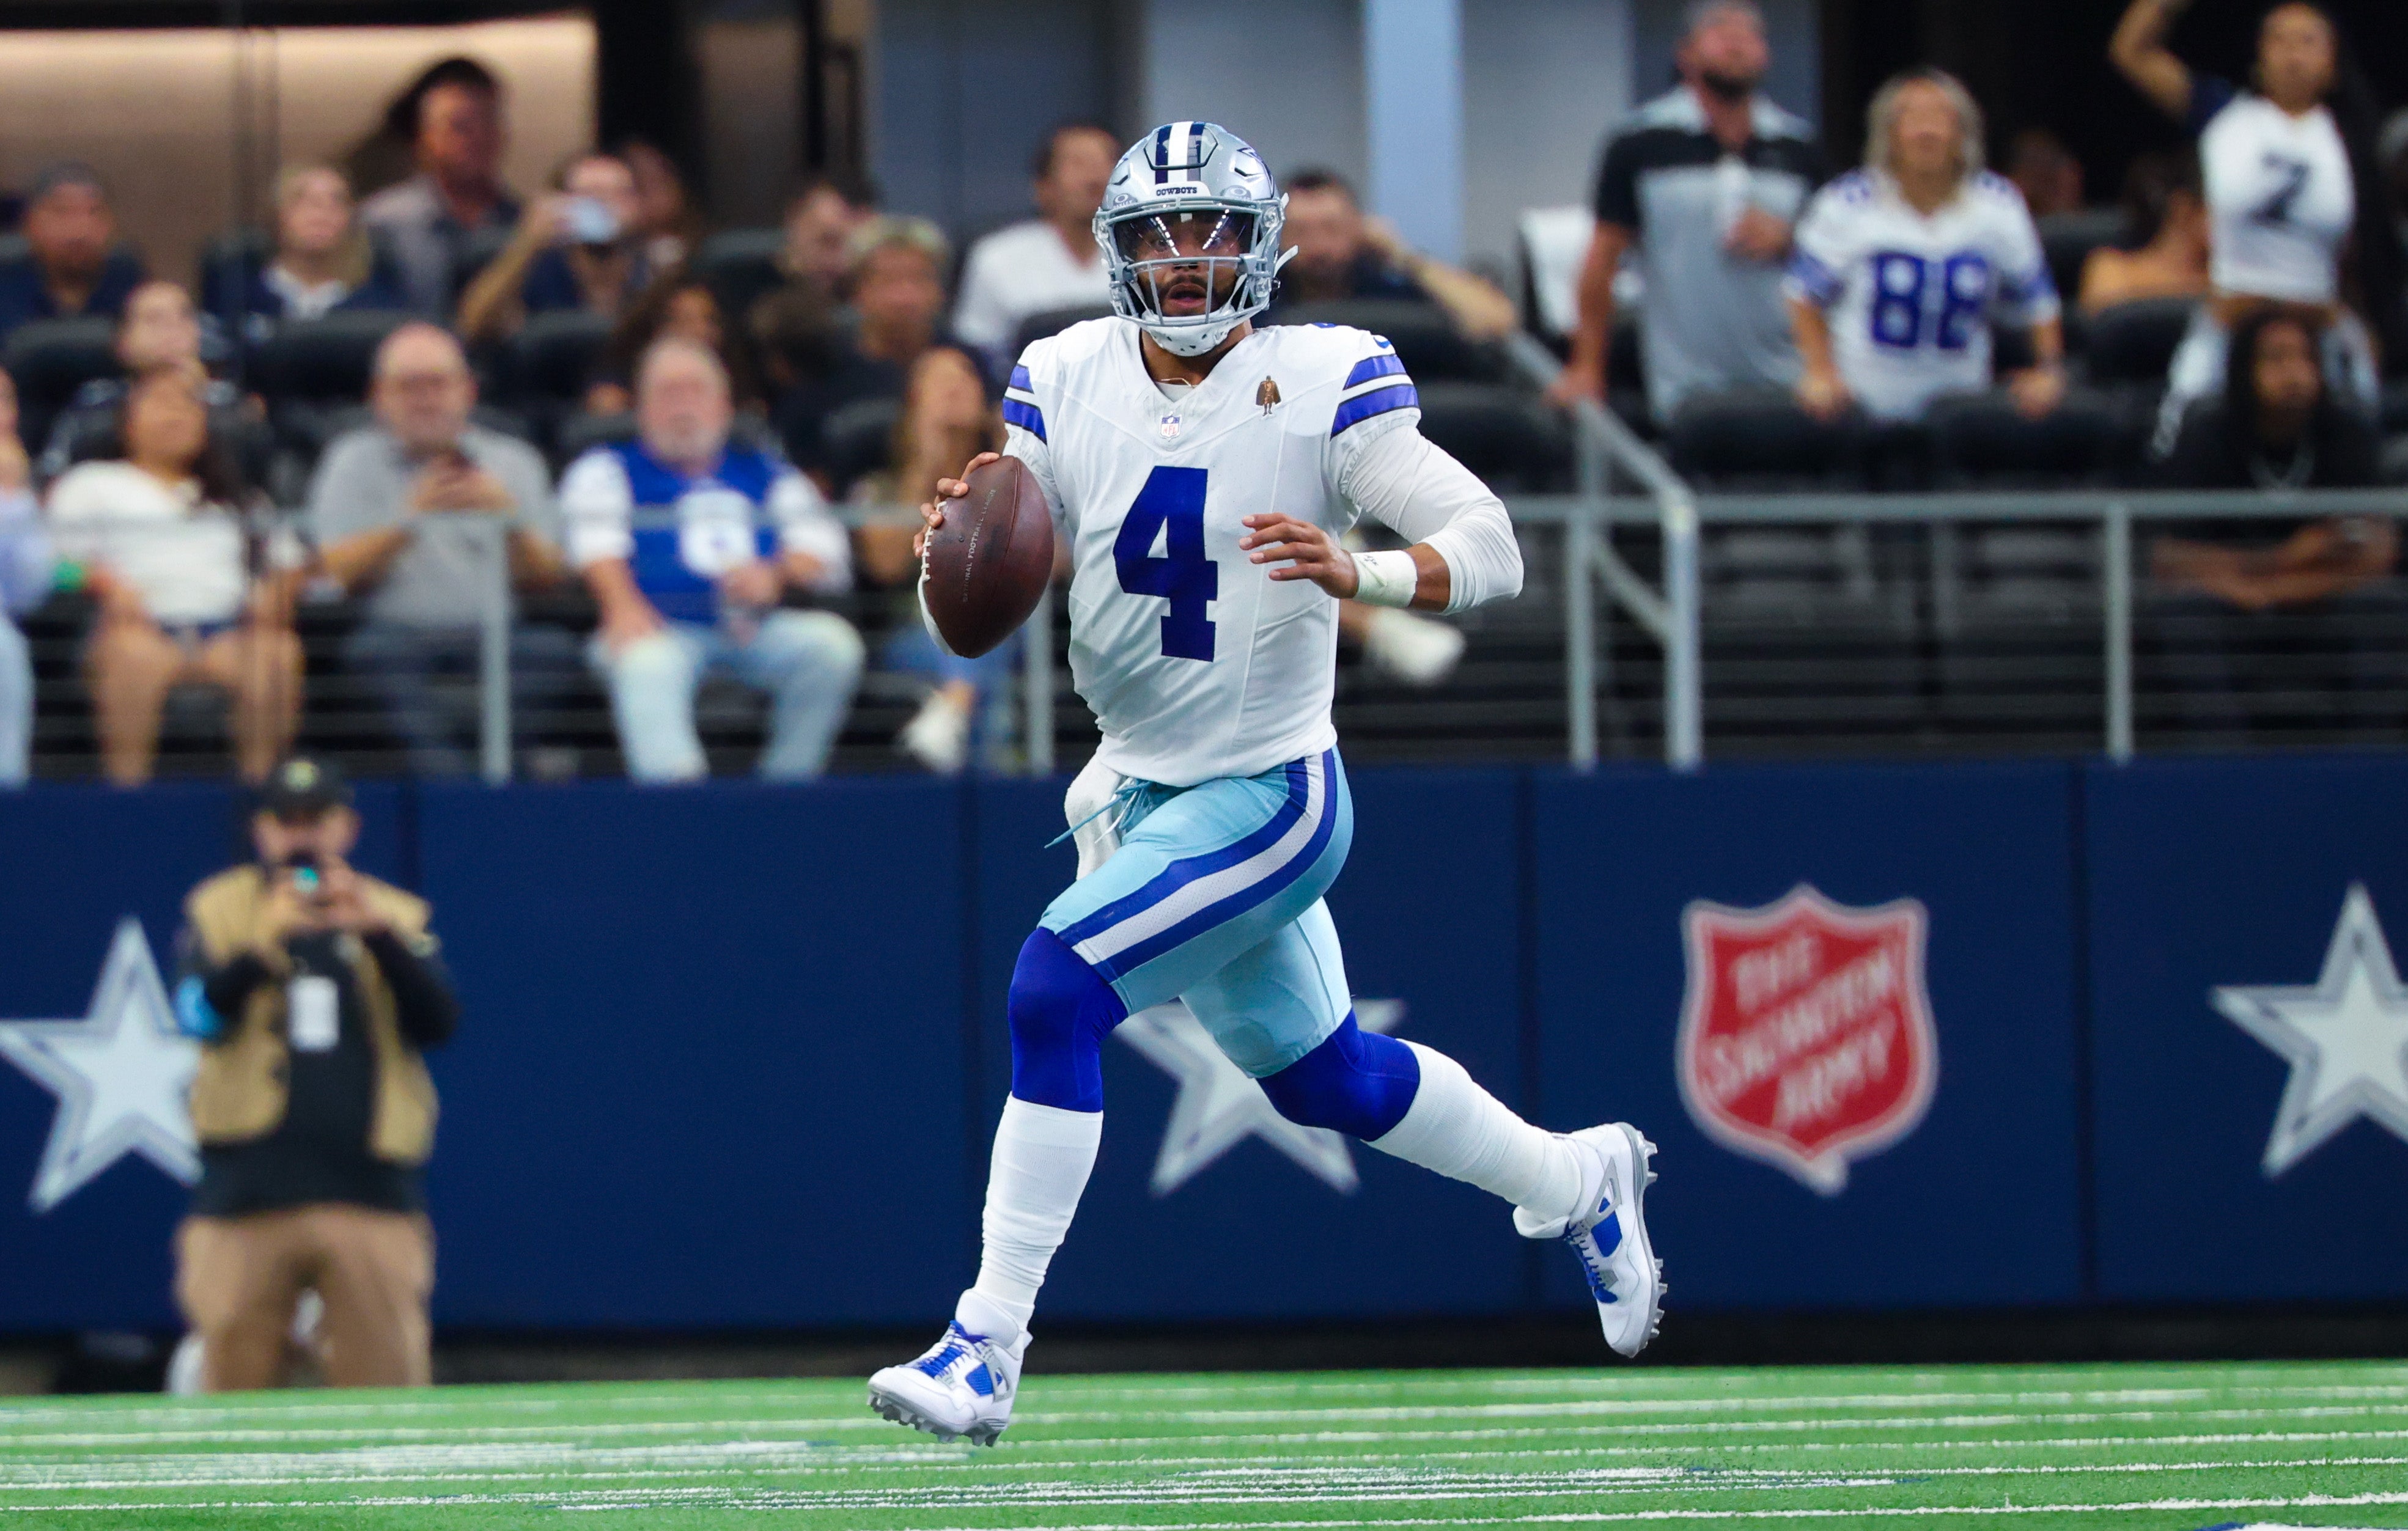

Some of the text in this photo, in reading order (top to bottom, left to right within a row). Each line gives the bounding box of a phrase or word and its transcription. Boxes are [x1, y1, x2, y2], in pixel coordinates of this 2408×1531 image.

[1156, 187, 1198, 196] COWBOYS
[1163, 424, 1177, 435] NFL
[967, 517, 984, 559] FOOTBALL
[1113, 465, 1218, 663] 4
